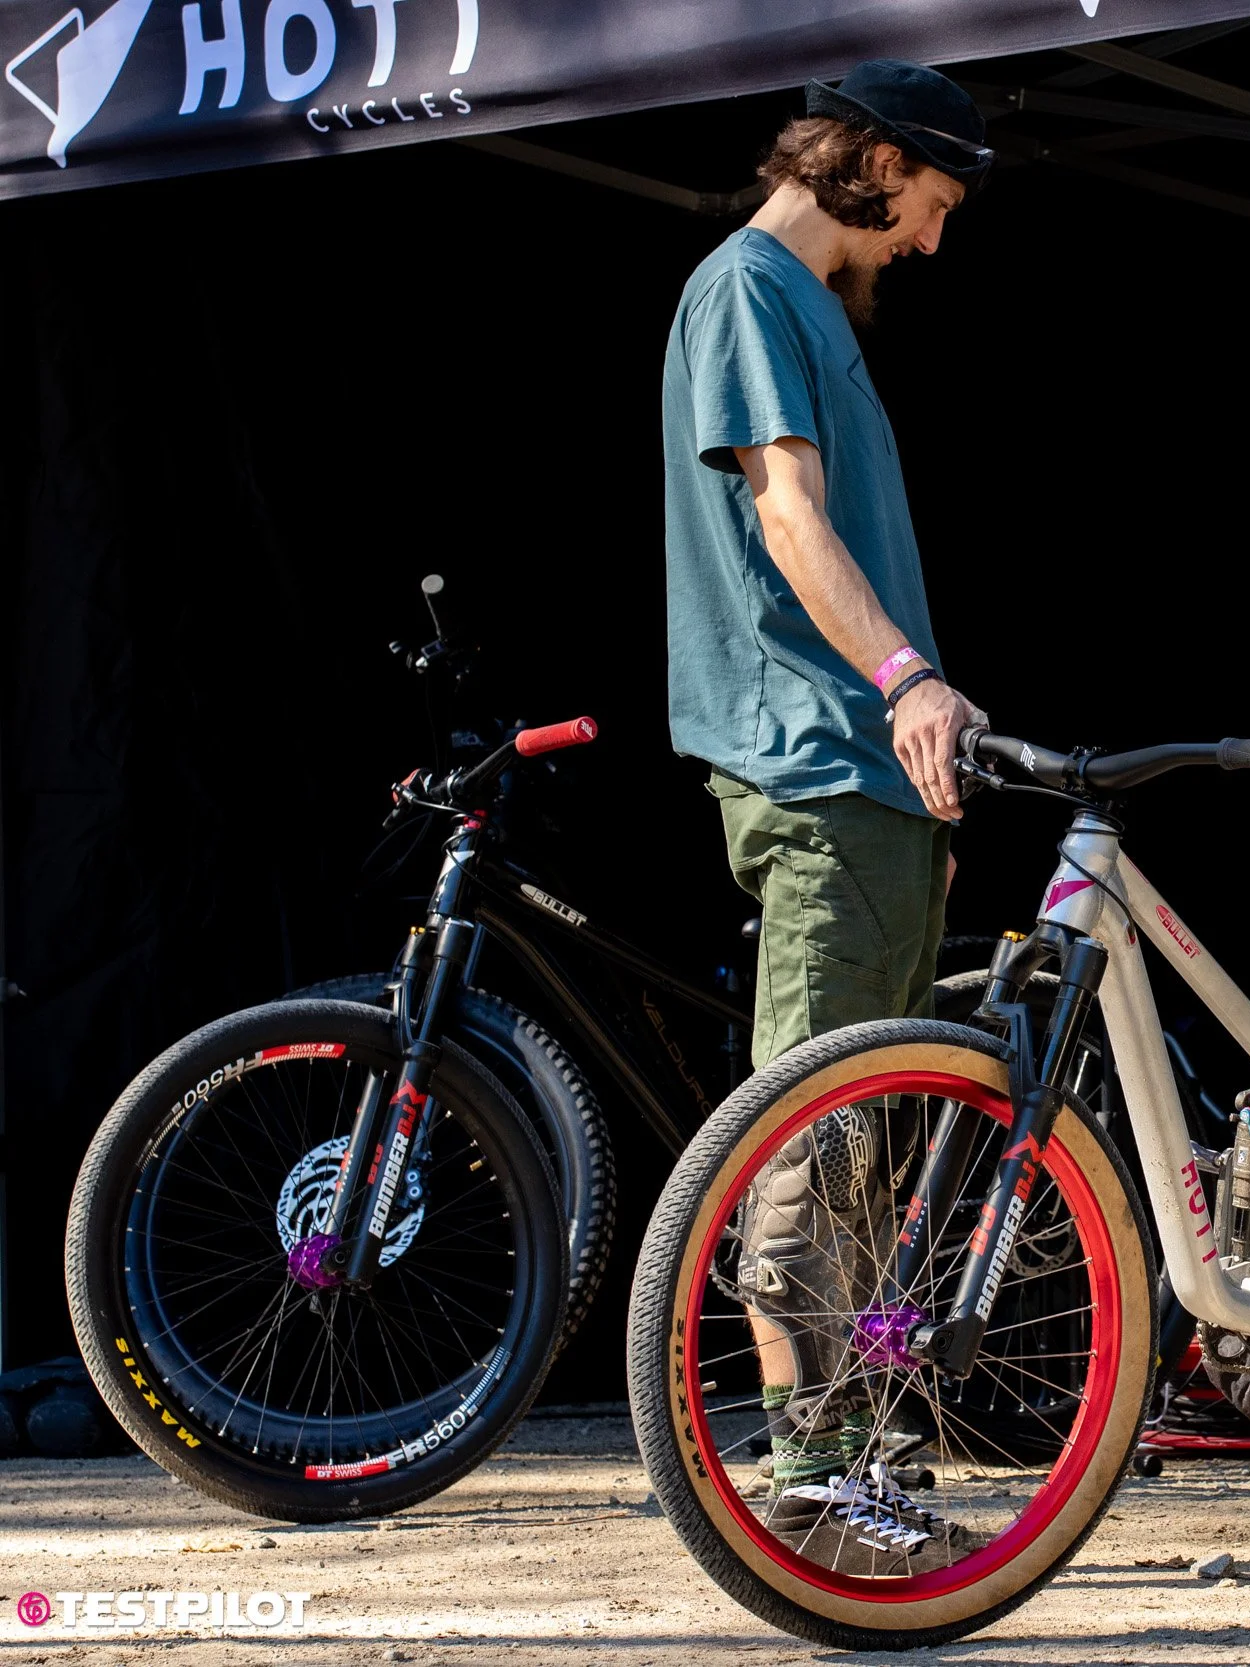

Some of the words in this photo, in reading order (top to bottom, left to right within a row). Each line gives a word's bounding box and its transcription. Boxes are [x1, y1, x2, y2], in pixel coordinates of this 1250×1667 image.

[306, 87, 472, 133] CYCLES
[532, 890, 588, 927] BULLET
[1162, 916, 1201, 960] BULLET
[289, 1044, 317, 1054] SWISS
[184, 1050, 263, 1112] FR560
[114, 1336, 201, 1448] MAXXIS
[675, 1317, 706, 1479] MAXXIS
[387, 1408, 466, 1470] FR560
[317, 1470, 333, 1479] DT
[334, 1468, 362, 1479] SWISS
